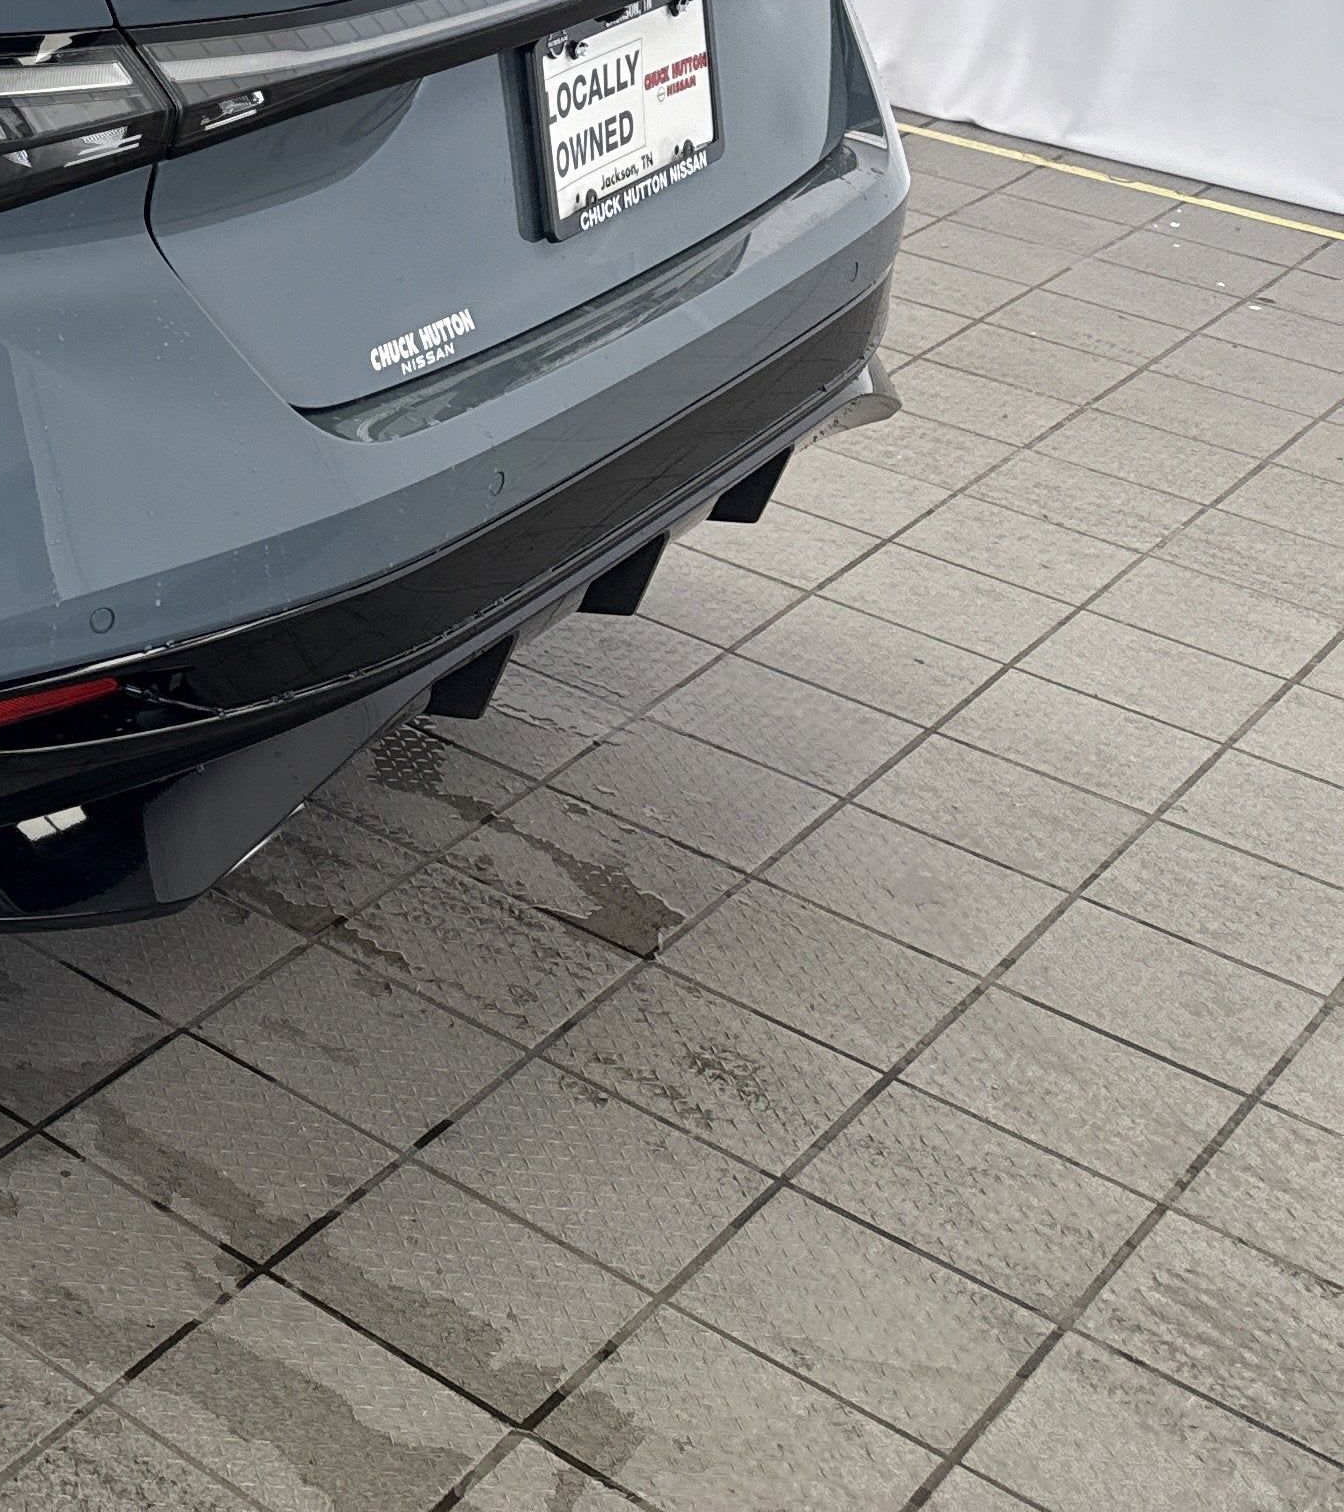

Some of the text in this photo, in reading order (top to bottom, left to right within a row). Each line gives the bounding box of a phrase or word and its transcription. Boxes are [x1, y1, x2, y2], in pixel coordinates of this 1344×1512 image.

[545, 50, 640, 125] LOCALLY
[644, 51, 707, 90] CHUCK HUTTON
[666, 75, 696, 97] NISSAN
[557, 110, 634, 178] OWNED
[580, 150, 707, 230] CHUCK HUTTON NISSAN
[601, 151, 653, 190] Jackson, TN
[371, 309, 475, 370] CHUCK HUTTON
[401, 342, 455, 375] NISSAN
